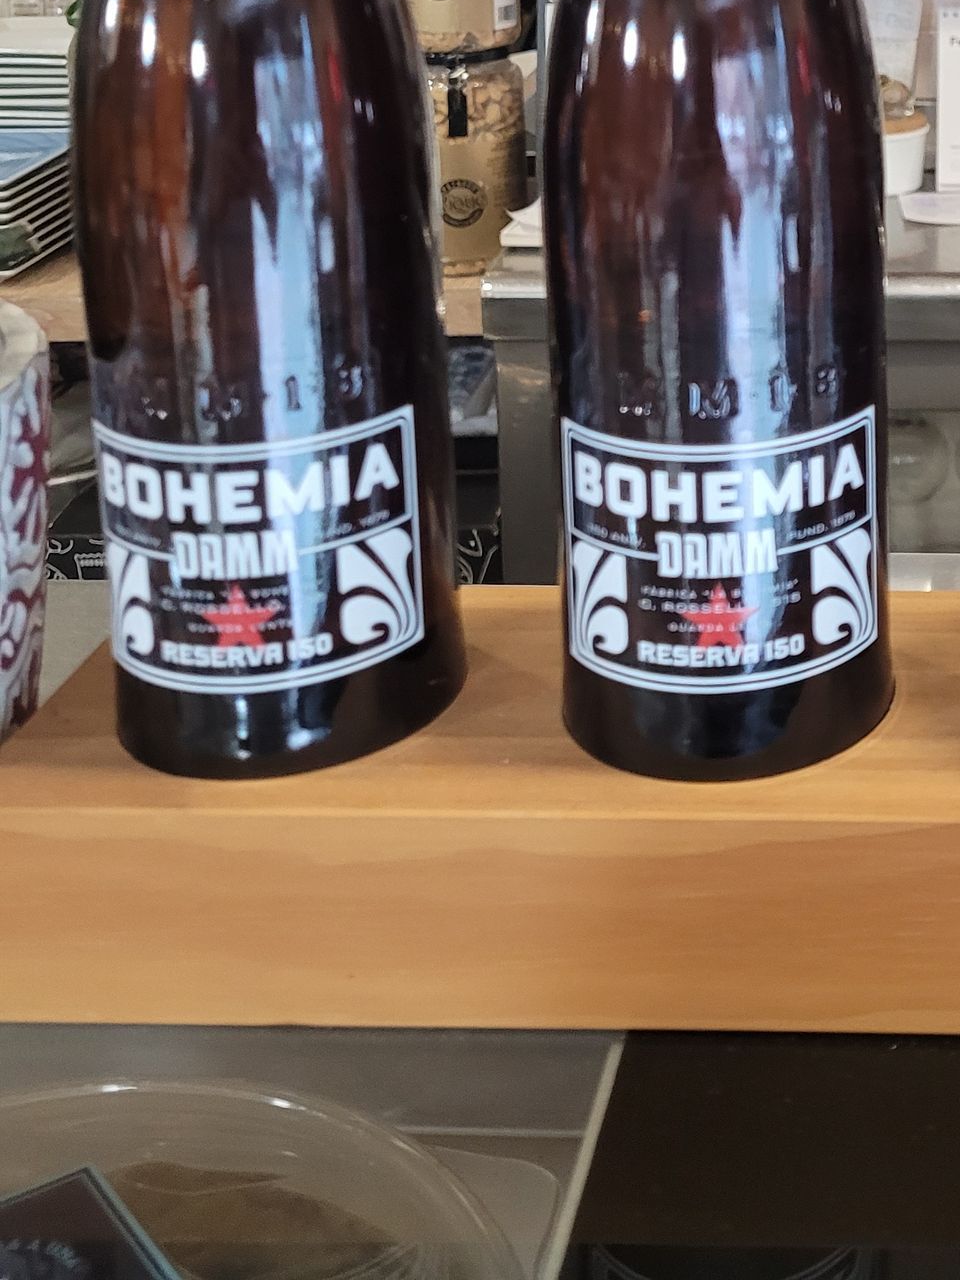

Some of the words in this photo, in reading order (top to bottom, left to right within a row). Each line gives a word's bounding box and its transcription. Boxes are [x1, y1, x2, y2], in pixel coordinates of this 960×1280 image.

[102, 442, 400, 524] BOHEMIA
[574, 442, 865, 524] BOHEMIA
[170, 528, 299, 580] DAMM
[655, 527, 779, 580] DAMM
[160, 639, 284, 669] RESERVA
[286, 632, 334, 662] 150
[637, 640, 761, 668] RESERVA
[764, 634, 806, 662] 150
